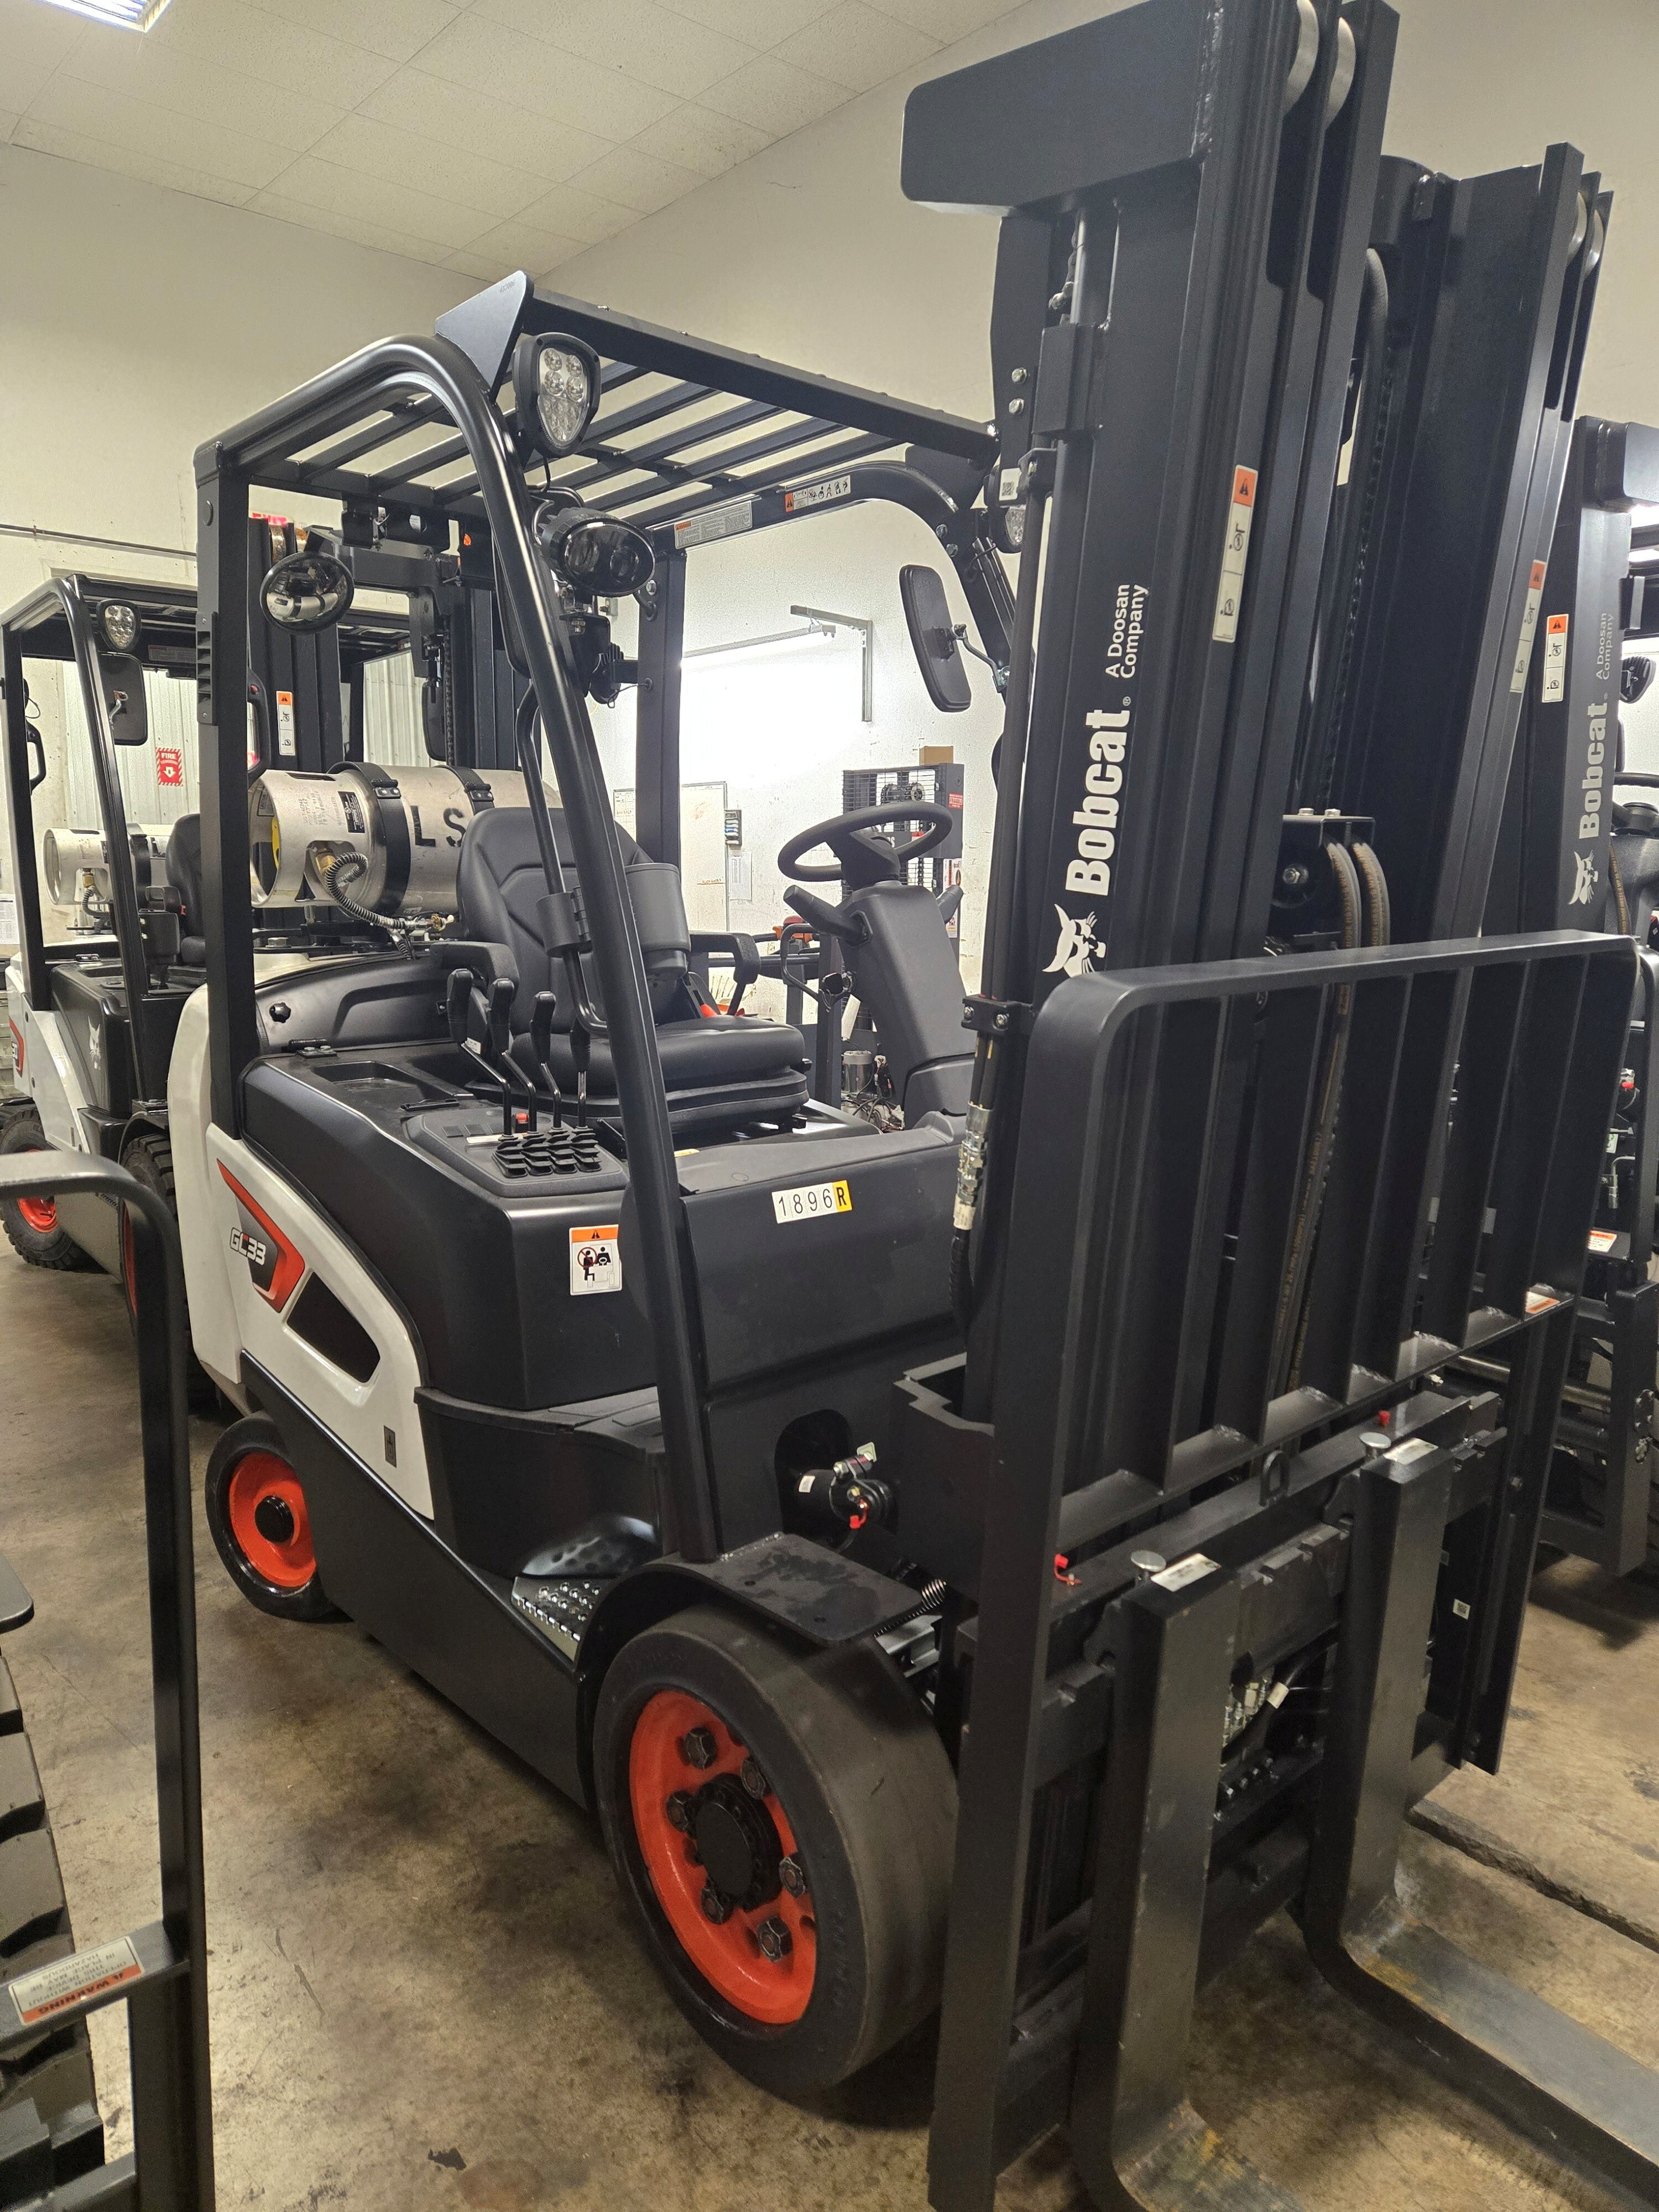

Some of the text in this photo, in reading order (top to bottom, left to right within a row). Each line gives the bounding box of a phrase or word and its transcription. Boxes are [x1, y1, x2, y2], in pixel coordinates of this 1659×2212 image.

[1106, 585, 1130, 678] A Doosan
[1120, 585, 1149, 678] Company
[1596, 613, 1606, 680] A Doosan
[1603, 614, 1614, 680] Company
[1065, 709, 1130, 896] Bobcat
[1579, 703, 1608, 839] Bobcat
[230, 1227, 266, 1265] GC33
[37, 1979, 109, 2015] WARNING
